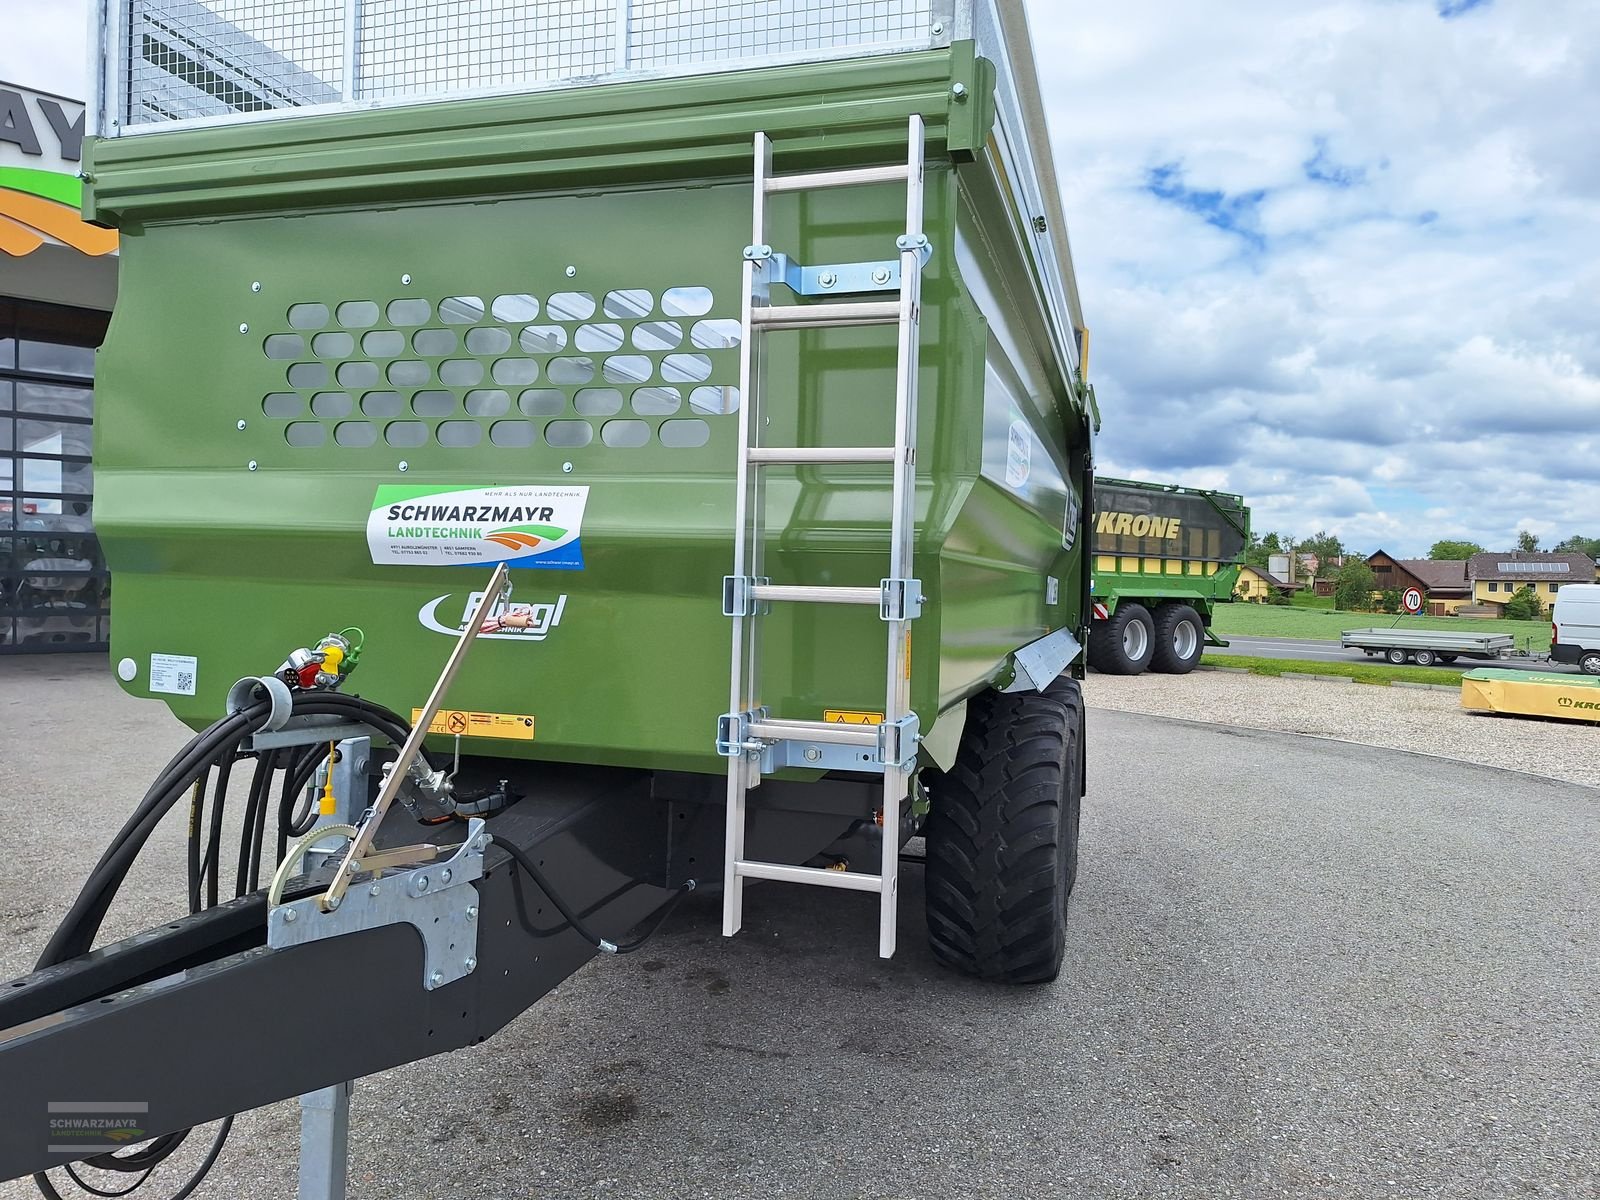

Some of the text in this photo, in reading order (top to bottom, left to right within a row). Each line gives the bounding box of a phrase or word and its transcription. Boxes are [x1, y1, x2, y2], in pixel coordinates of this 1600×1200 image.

[387, 505, 554, 523] SCHWARZMAYR
[388, 527, 482, 539] LANDTECHNIK
[1096, 511, 1181, 539] KRONE
[1408, 593, 1419, 607] 70
